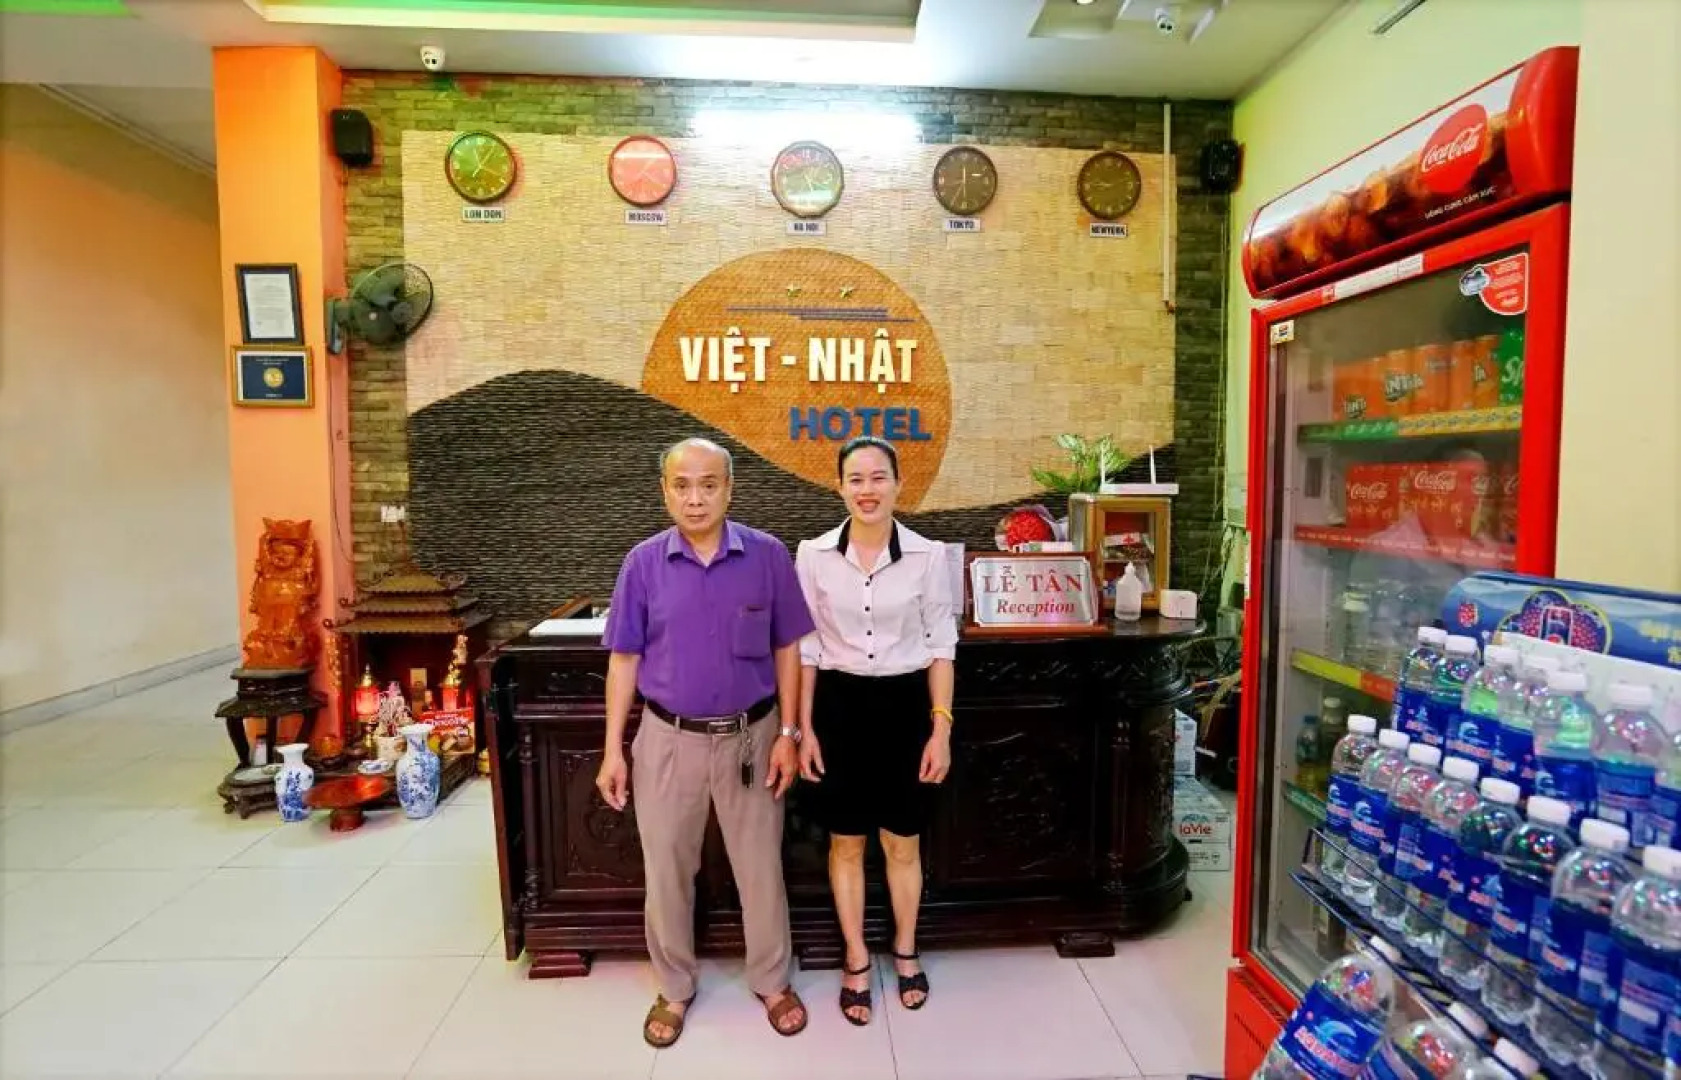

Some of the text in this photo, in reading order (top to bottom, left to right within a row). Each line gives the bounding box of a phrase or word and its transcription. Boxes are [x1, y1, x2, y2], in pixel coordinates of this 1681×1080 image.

[628, 212, 664, 222] MOSCOW
[949, 219, 975, 229] TOKYO
[680, 326, 771, 393] VIỆT
[808, 327, 918, 394] NHẬT
[788, 406, 932, 440] HOTEL
[982, 565, 1083, 593] LỄ TÂN
[996, 598, 1075, 617] Reception
